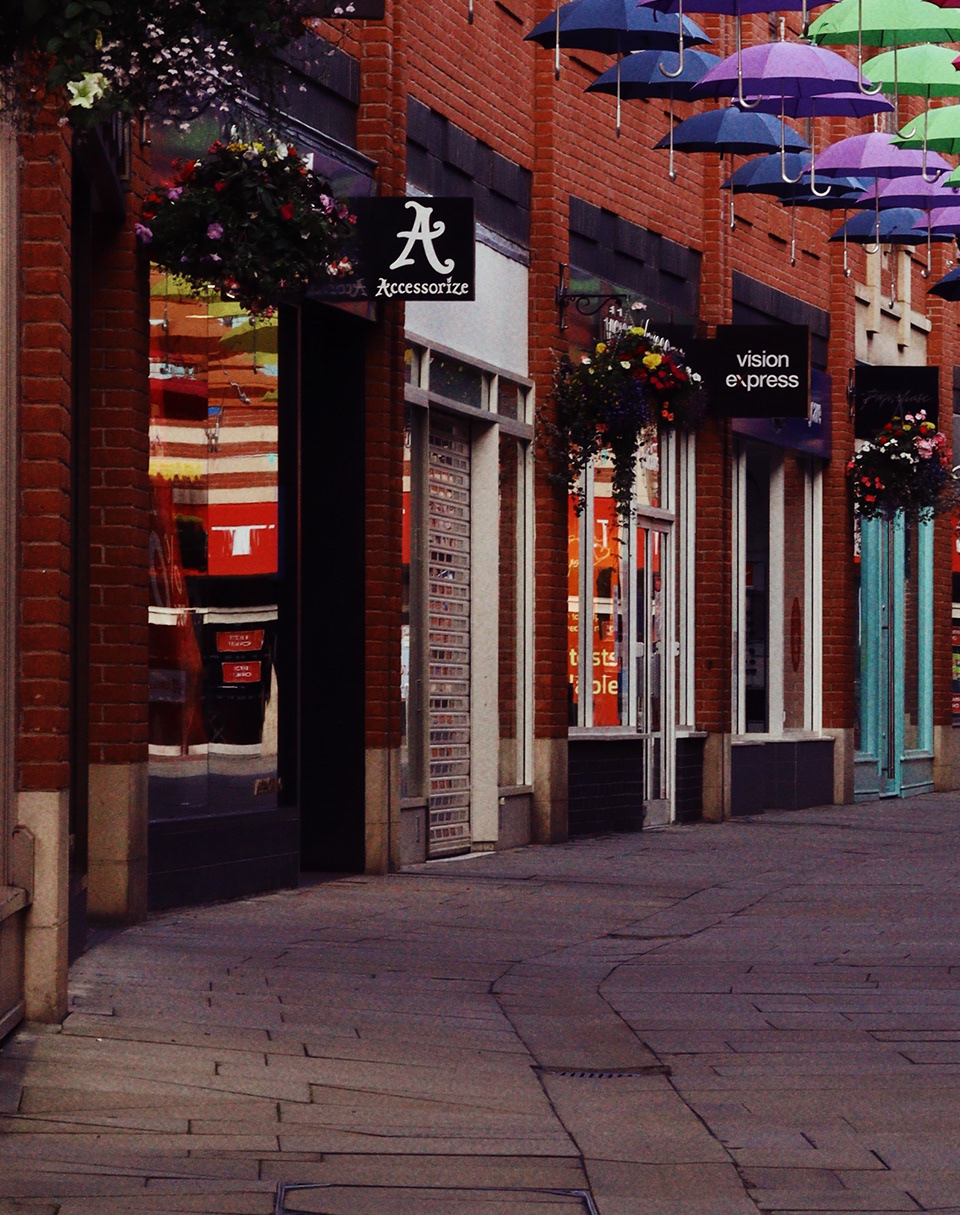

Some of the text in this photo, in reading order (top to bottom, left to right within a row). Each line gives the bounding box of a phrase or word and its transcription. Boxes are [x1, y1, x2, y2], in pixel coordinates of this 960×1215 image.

[389, 200, 455, 275] A
[375, 276, 469, 297] Accessorize
[737, 350, 790, 367] vision
[725, 374, 800, 391] express
[569, 648, 618, 667] tsts
